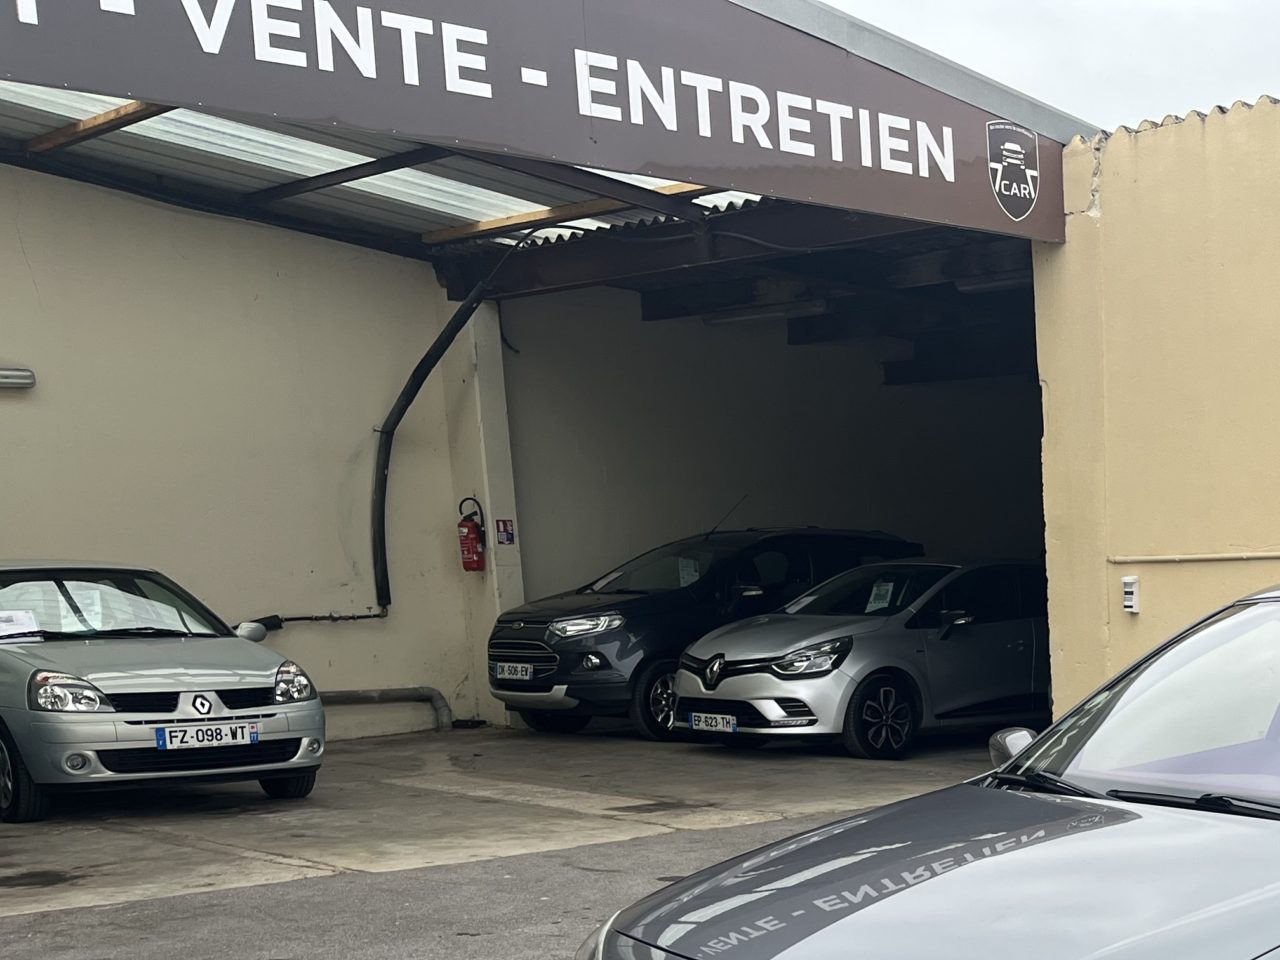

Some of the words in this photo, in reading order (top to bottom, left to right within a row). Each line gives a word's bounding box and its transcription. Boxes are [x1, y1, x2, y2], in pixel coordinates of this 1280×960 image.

[180, 0, 493, 98] VENTE
[574, 48, 956, 183] ENTRETIEN
[168, 727, 247, 745] FZ-098-WT
